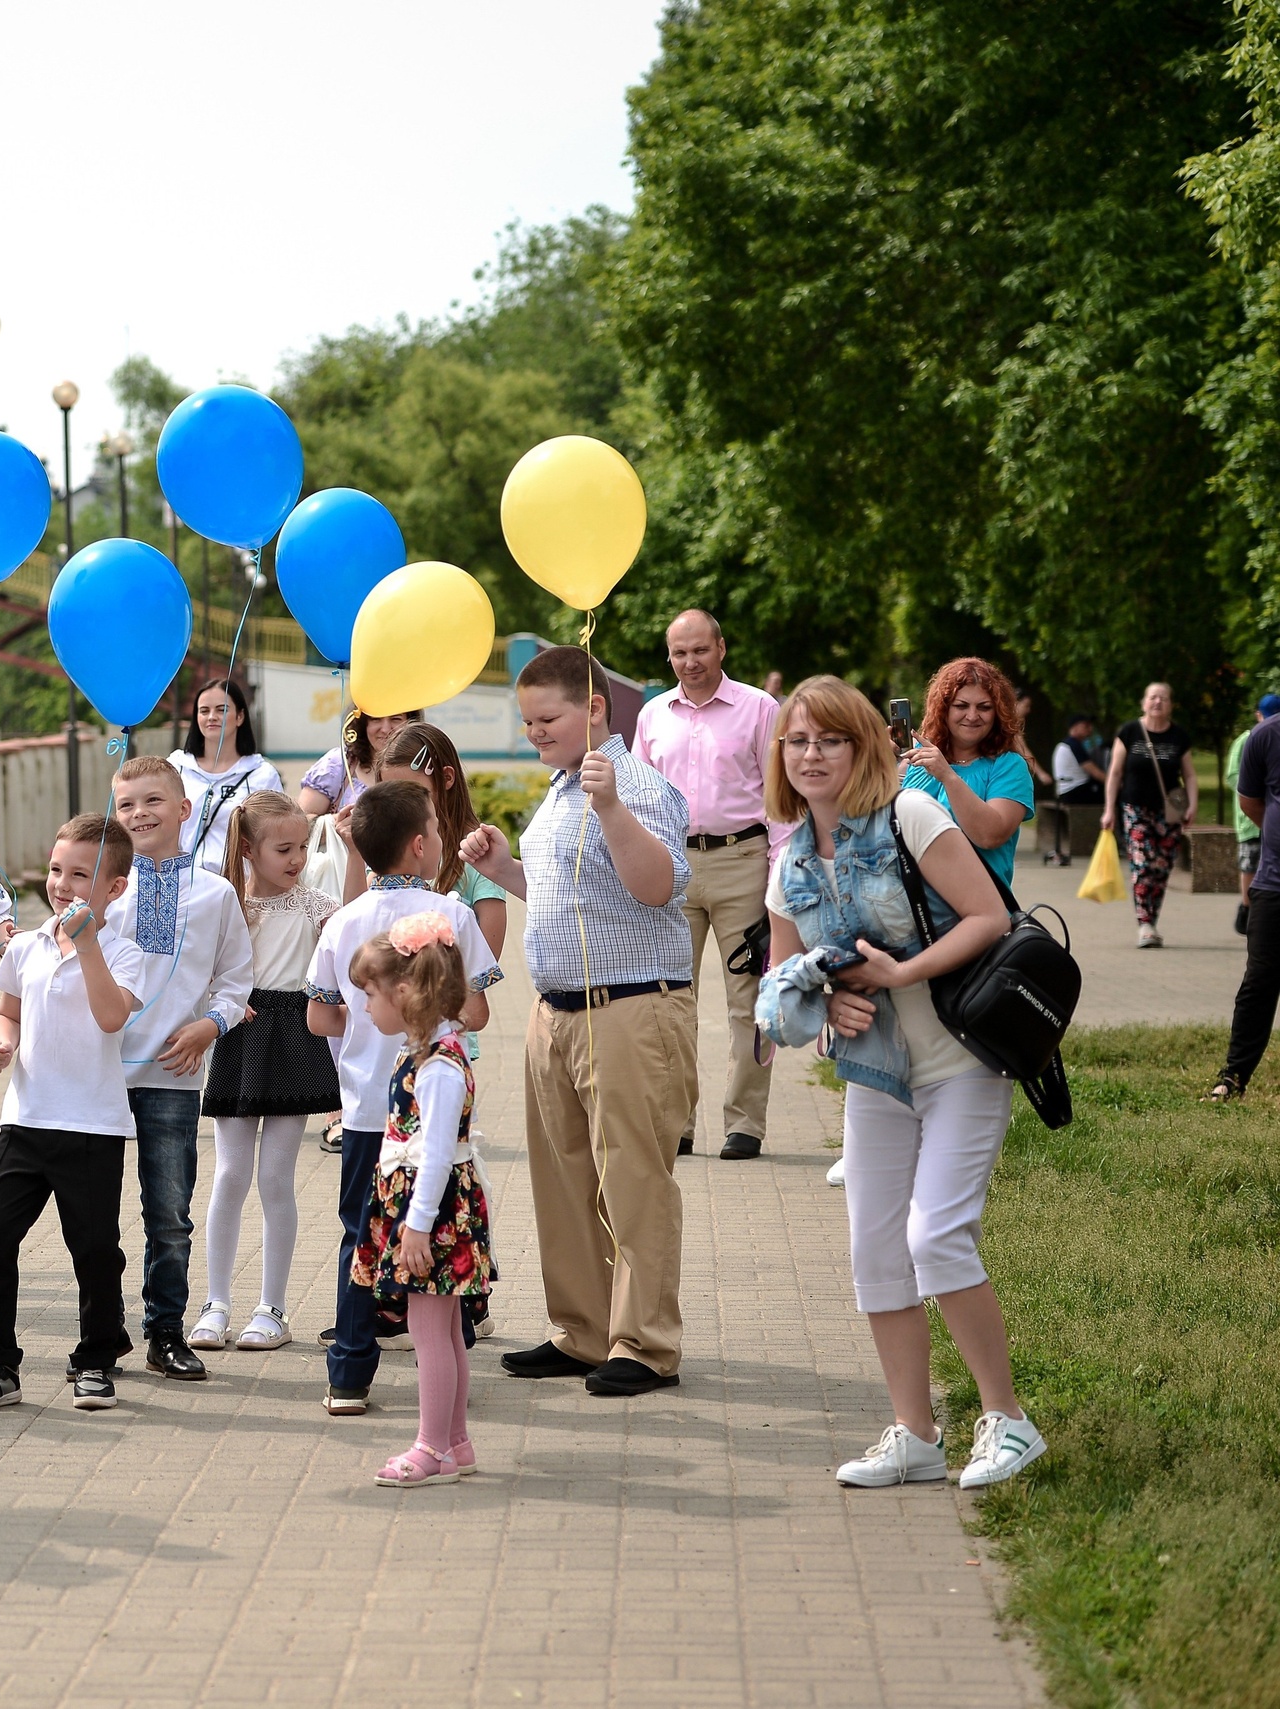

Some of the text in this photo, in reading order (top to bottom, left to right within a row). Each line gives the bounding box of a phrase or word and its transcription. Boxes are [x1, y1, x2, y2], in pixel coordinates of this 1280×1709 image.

[916, 903, 928, 933] FASHION
[1017, 984, 1062, 1029] FASHION STYLE
